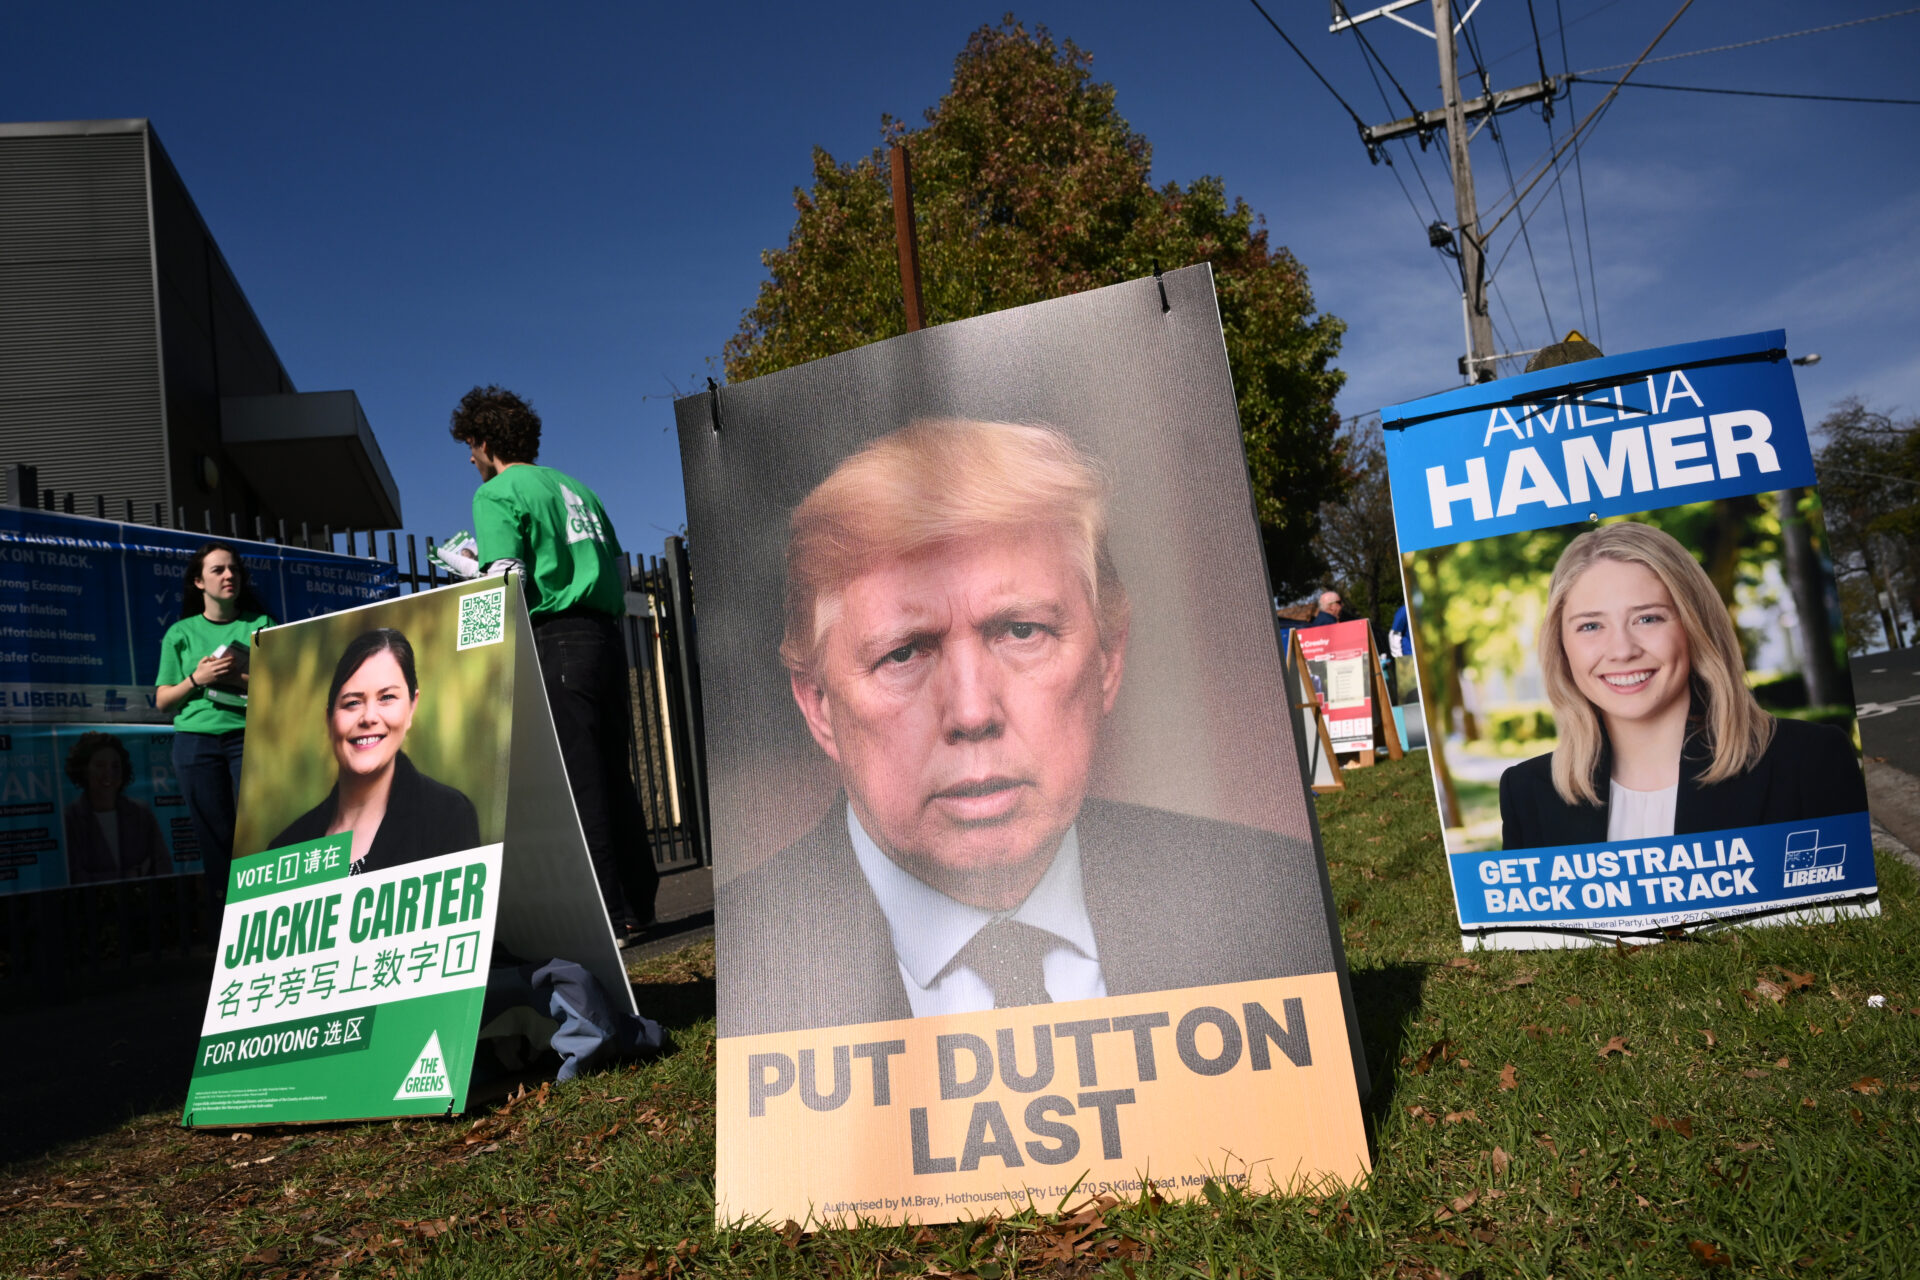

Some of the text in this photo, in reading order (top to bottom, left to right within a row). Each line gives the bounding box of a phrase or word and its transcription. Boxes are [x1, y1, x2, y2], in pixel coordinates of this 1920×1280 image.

[1483, 369, 1704, 447] AMELIA
[1425, 409, 1781, 529] HAMER
[24, 532, 113, 552] AUSTRALIA
[11, 548, 35, 563] ON
[38, 551, 93, 569] TRACK.
[0, 579, 83, 596] trong Economy
[305, 579, 336, 595] BACK
[19, 603, 67, 617] Inflation
[58, 629, 97, 642] Homes
[31, 652, 104, 666] Communities
[13, 691, 92, 708] LIBERAL
[236, 863, 275, 889] VOTE
[303, 844, 342, 875] 请在
[1478, 837, 1755, 886] GET AUSTRALIA
[1783, 866, 1846, 888] LIBERAL
[1483, 867, 1759, 914] BACK ON TRACK
[224, 862, 487, 970] JACKIE CARTER
[1587, 920, 1617, 929] Liberal
[217, 941, 439, 1020] 名字旁写上数字
[203, 1015, 365, 1067] FOR KOOYONG 选区
[419, 1057, 439, 1074] THE
[748, 997, 1313, 1119] PUT DUTTON
[405, 1075, 445, 1093] GREENS
[909, 1088, 1137, 1176] LAST
[823, 1198, 883, 1213] Authorised
[885, 1197, 899, 1211] by
[946, 1190, 1026, 1205] Hothousemag
[1027, 1186, 1046, 1200] Pty
[1113, 1179, 1144, 1192] Kilda
